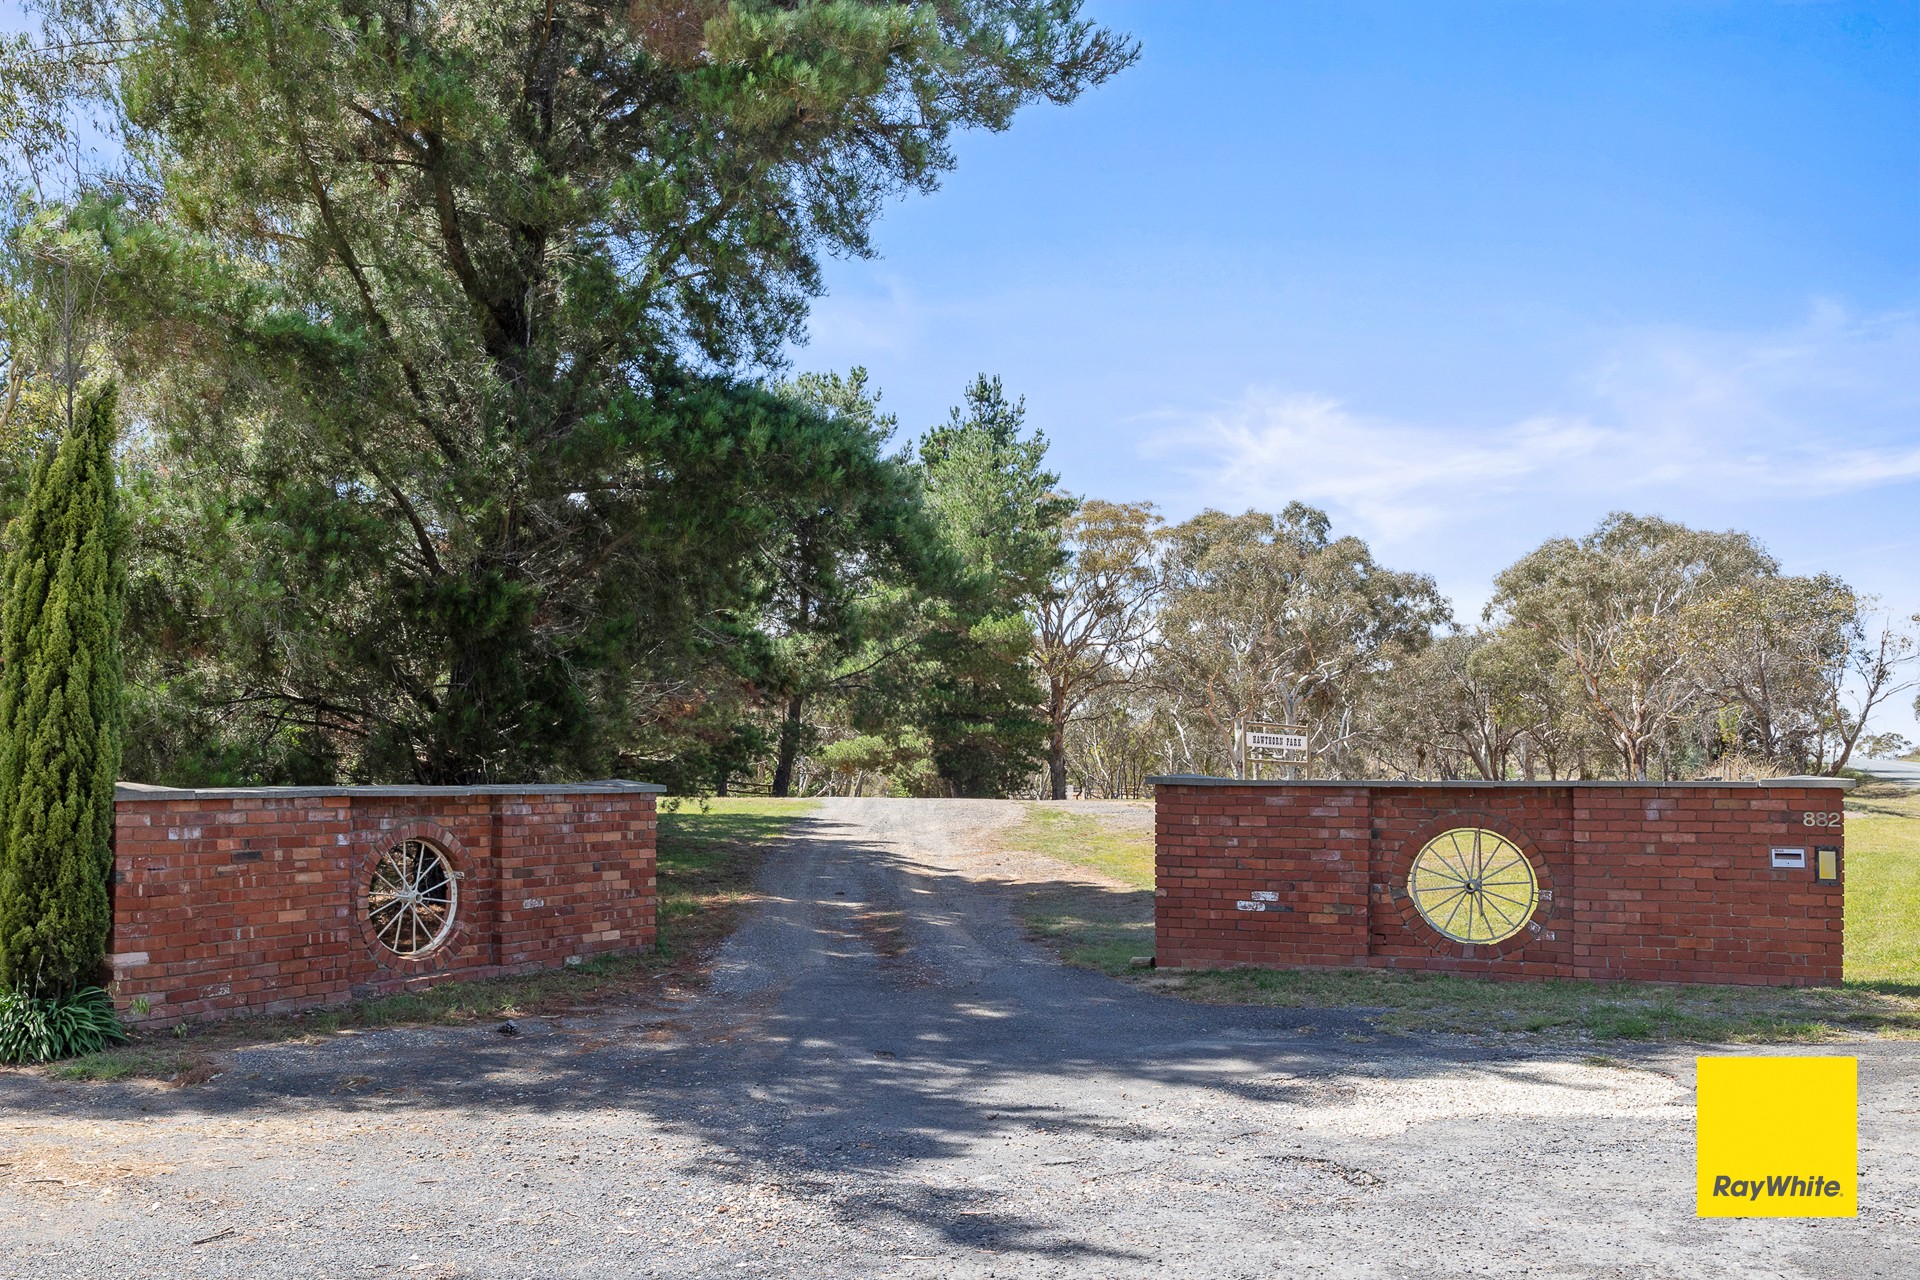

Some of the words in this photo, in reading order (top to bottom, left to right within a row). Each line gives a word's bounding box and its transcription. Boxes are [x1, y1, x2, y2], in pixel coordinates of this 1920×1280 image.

[1252, 735, 1284, 746] HAWTHORN
[1286, 737, 1302, 747] PARK
[1802, 811, 1841, 828] 882
